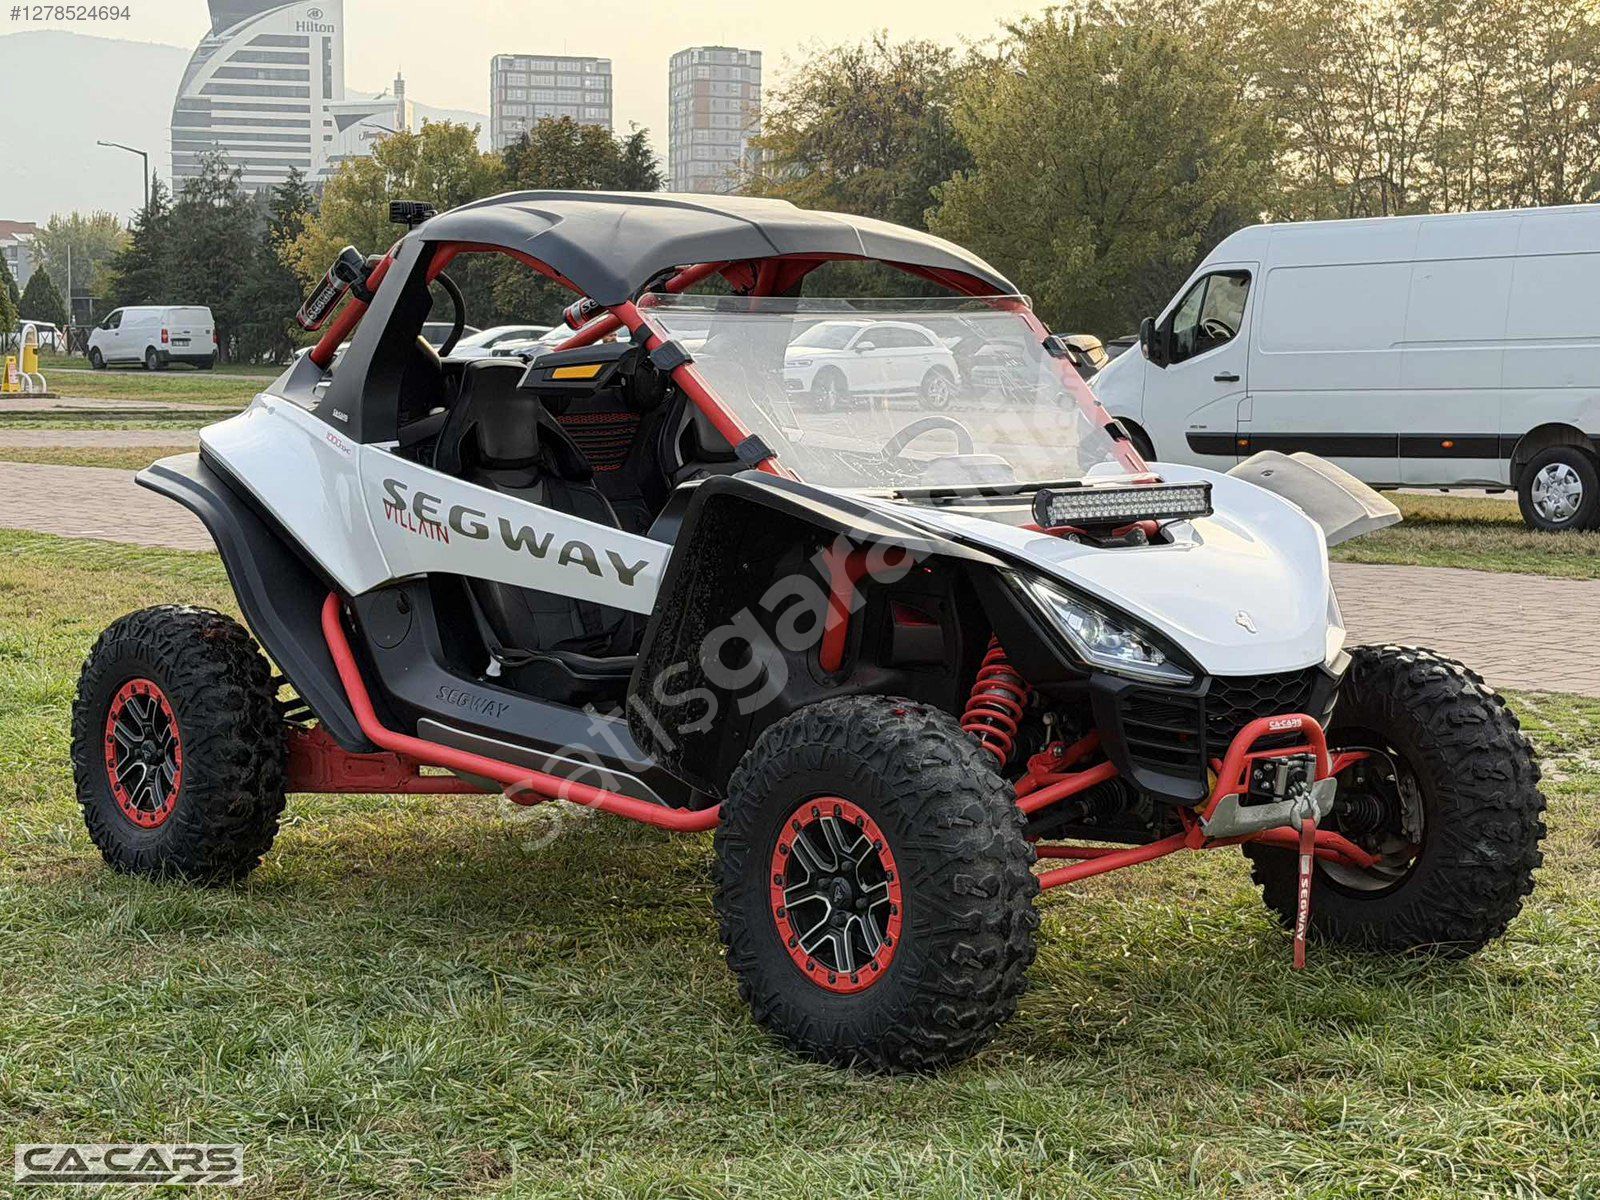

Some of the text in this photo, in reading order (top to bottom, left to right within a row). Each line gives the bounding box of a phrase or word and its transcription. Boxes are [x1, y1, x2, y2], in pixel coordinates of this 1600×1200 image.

[296, 20, 335, 33] Hilton
[382, 478, 649, 587] SEGWAY
[383, 499, 450, 544] VILLAIN
[436, 685, 510, 718] SEGWAY
[1296, 877, 1309, 941] SEGWAY
